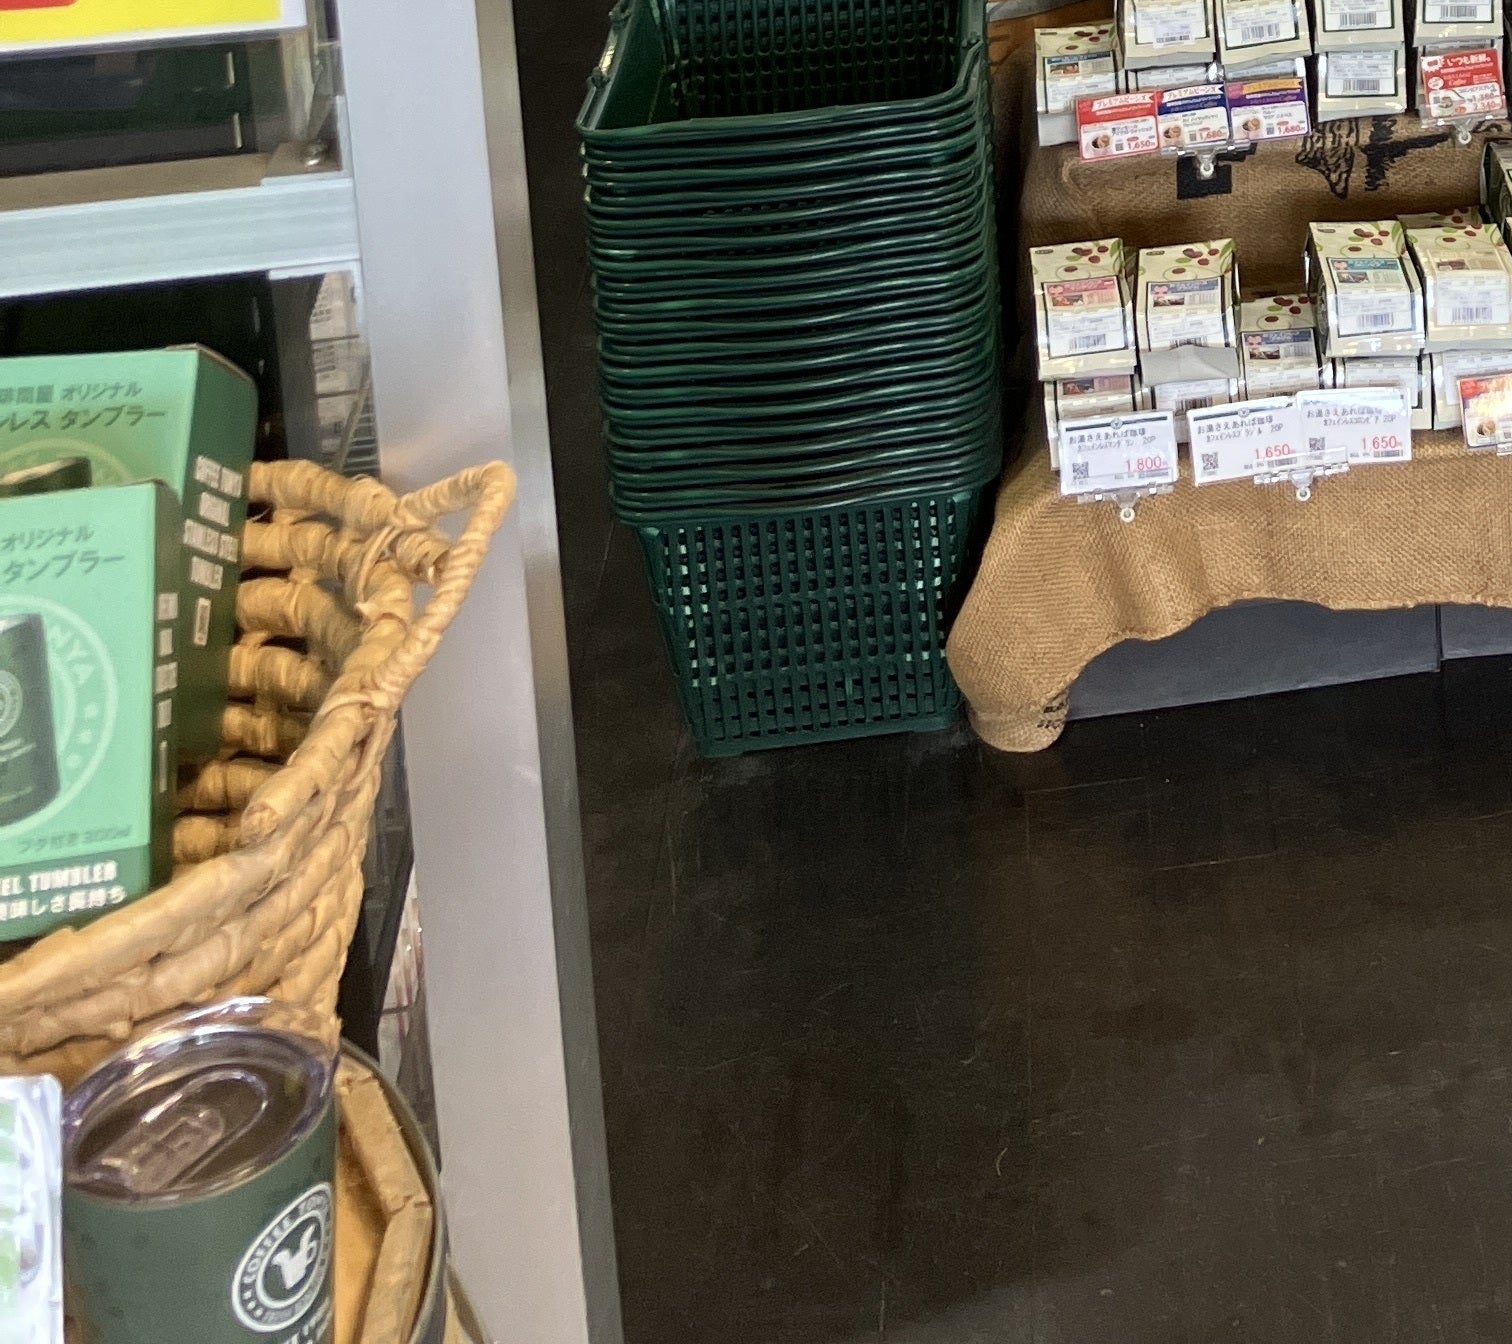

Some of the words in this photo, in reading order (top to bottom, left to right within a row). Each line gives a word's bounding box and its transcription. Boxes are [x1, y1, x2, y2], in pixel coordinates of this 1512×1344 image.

[61, 380, 143, 401] オリジナル
[61, 404, 166, 430] タンブラー
[2, 525, 94, 551] オリジナル
[4, 551, 126, 583] タンブラー
